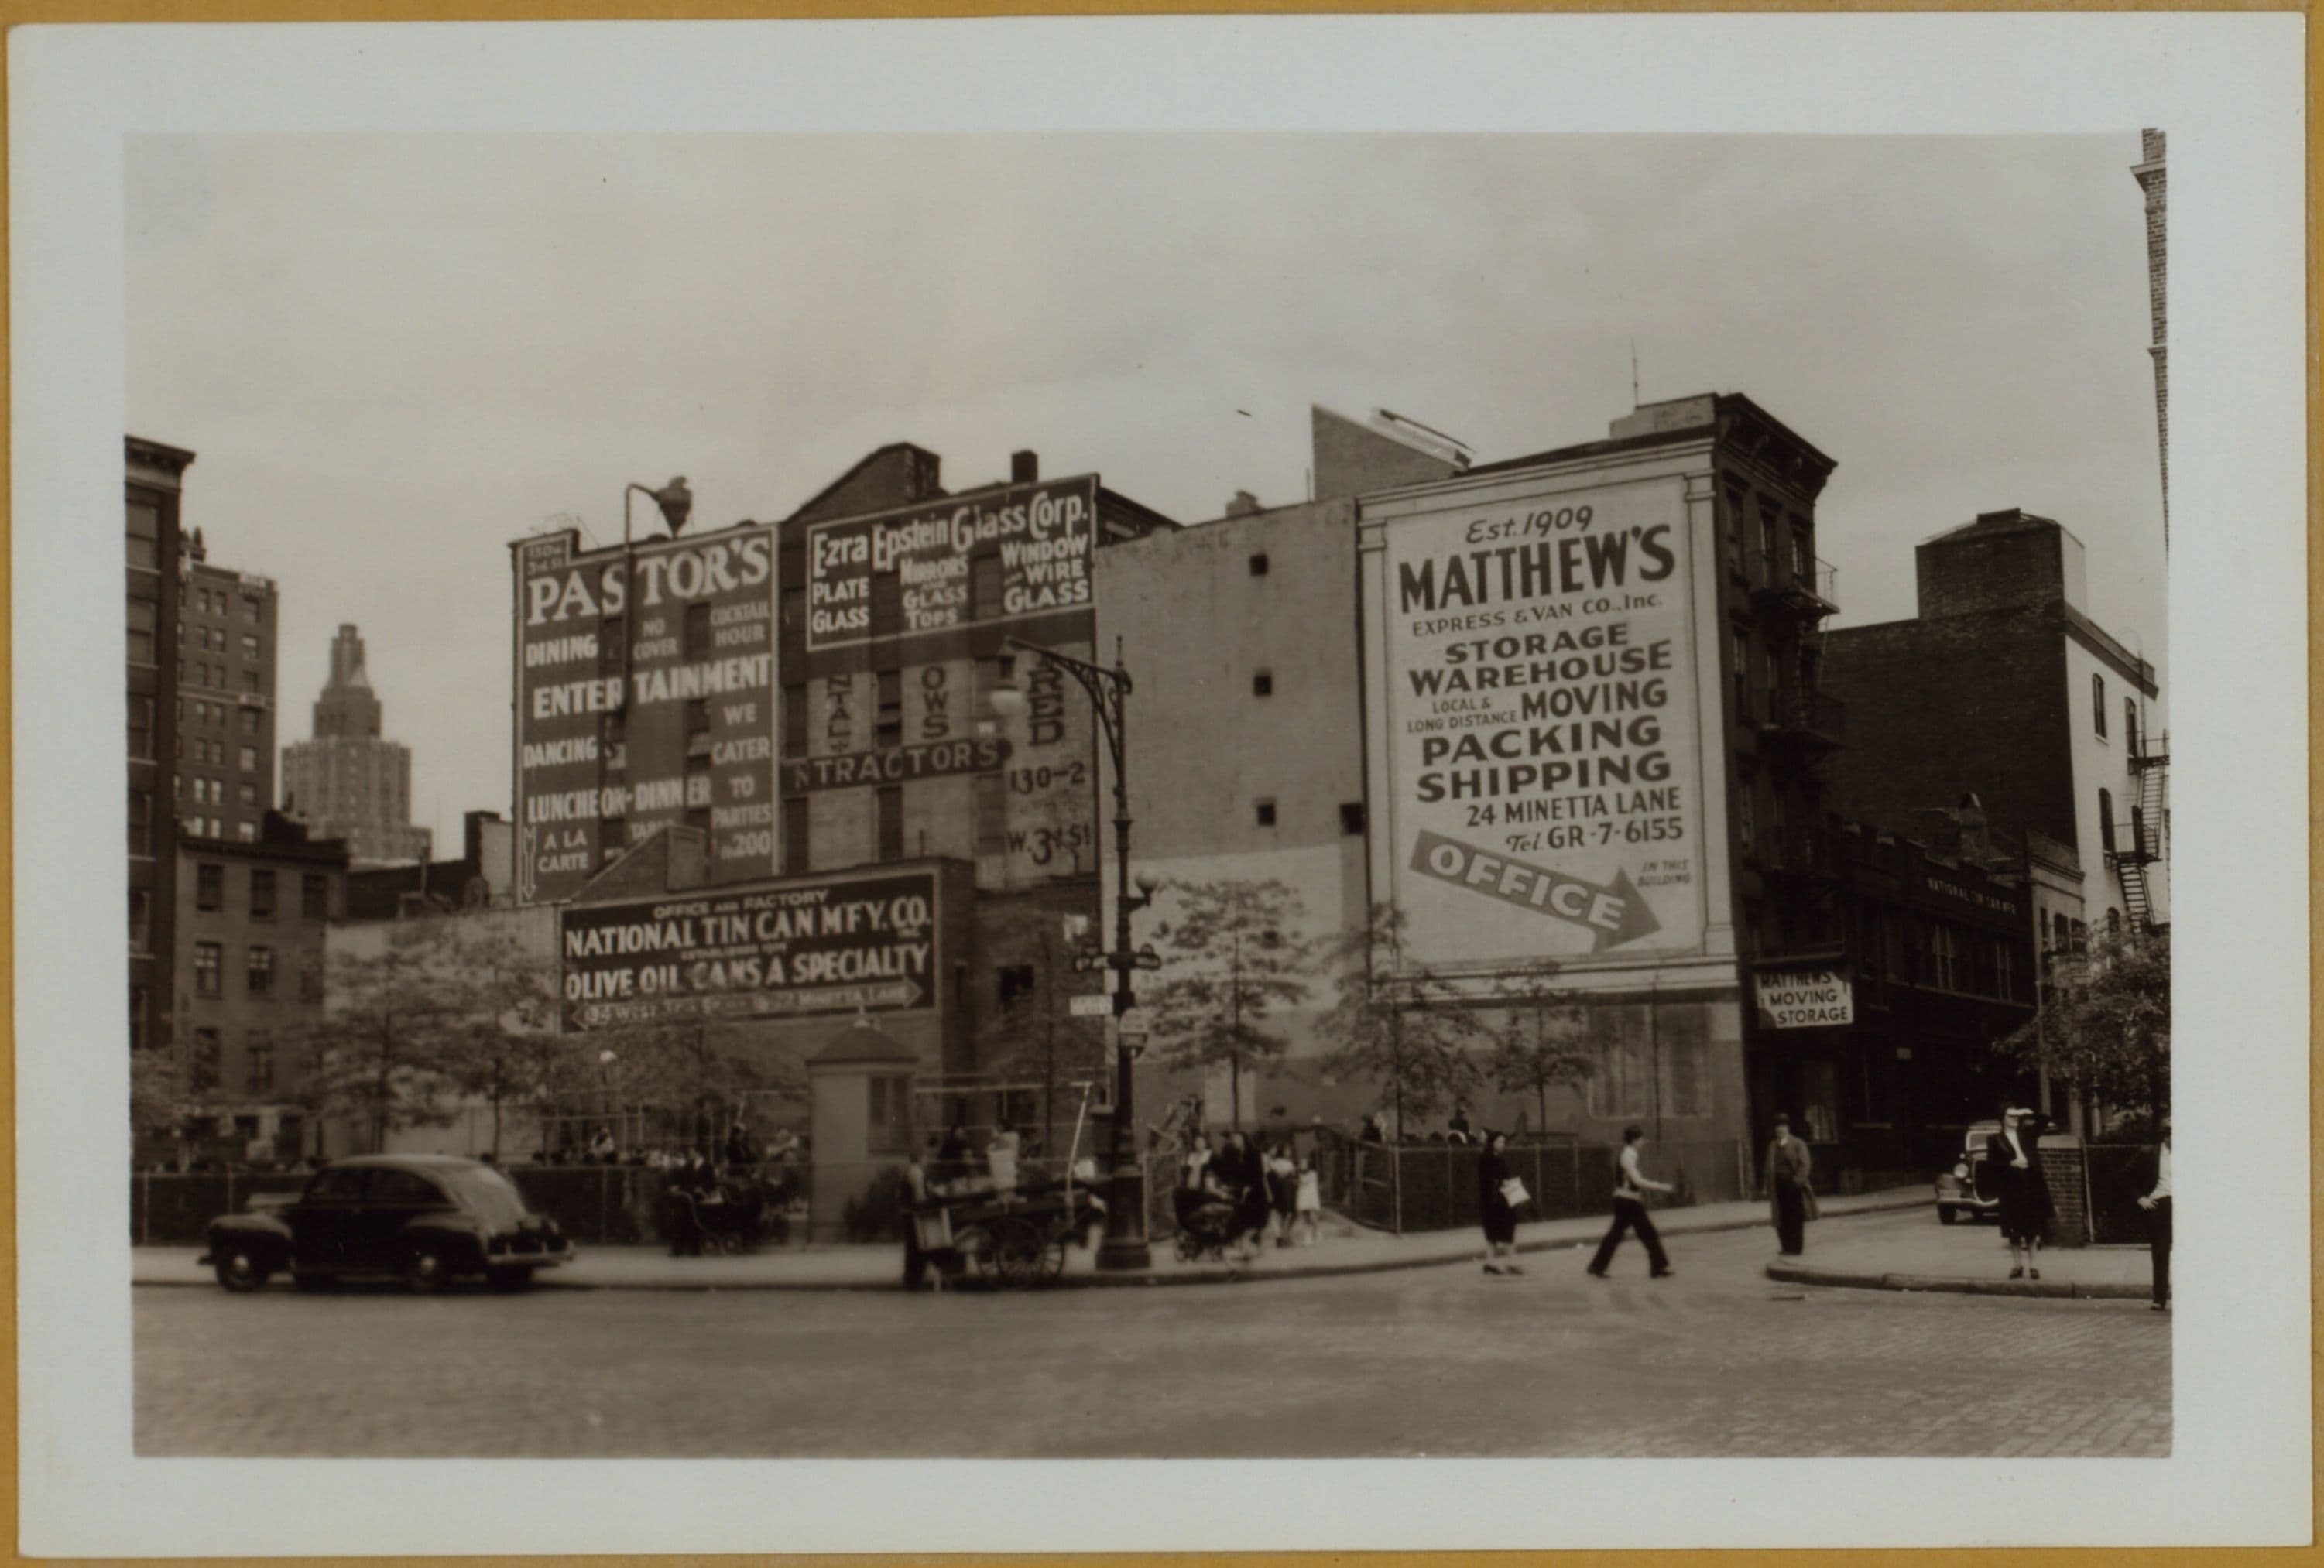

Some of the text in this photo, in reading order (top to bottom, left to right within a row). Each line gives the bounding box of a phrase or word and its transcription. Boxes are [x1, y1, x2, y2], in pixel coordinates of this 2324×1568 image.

[813, 491, 1088, 578] Ezra Epstein Glass Corp.
[1465, 505, 1594, 544] Est. 1909
[999, 534, 1088, 569] WINDOW
[526, 536, 770, 626] PASTOR'S
[900, 555, 968, 585] MIRRORS
[1024, 559, 1085, 586] WIRE
[1399, 524, 1674, 614] MATTHEW'S
[813, 577, 869, 605] PLATE
[903, 584, 968, 609] GLASS
[1004, 578, 1088, 614] GLASS
[642, 618, 666, 638] NO
[711, 600, 770, 627] COCKTAIL
[813, 607, 869, 634] GLASS
[905, 608, 958, 630] TOPS
[1413, 611, 1505, 637] EXPRESS
[1514, 610, 1528, 624] &
[1532, 603, 1572, 621] VAN
[525, 634, 598, 668] DINING
[632, 637, 678, 662] COVER
[715, 624, 766, 648] HOUR
[1445, 623, 1630, 666] STORAGE
[1408, 640, 1673, 697] WAREHOUSE
[722, 703, 758, 726] WE
[1432, 696, 1492, 714] LOCAL &
[1521, 678, 1668, 721] MOVING
[1407, 710, 1517, 733] LONG DISTANCE
[522, 736, 598, 769] DANCING
[711, 736, 771, 766] CATER
[1421, 714, 1661, 767] PACKING
[728, 774, 756, 799] TO
[1417, 751, 1671, 803] SHIPPING
[711, 803, 772, 830] PARTIES
[1467, 786, 1681, 827] 24 MINETTA LANE
[543, 827, 588, 850] A LA
[732, 829, 772, 858] 200
[538, 852, 589, 873] CARTE
[1428, 844, 1626, 930] OFFICE
[653, 901, 710, 919] OFFICE
[743, 889, 828, 911] FACTORY
[566, 919, 696, 957] NATIONAL
[701, 913, 750, 945] TIN
[755, 906, 813, 941] CAN
[890, 895, 932, 929] CO.
[566, 943, 930, 1001] OLIVE OIL CANS A SPECIALTY
[1770, 988, 1839, 1006] MOVING
[1777, 1006, 1848, 1025] STORAGE
